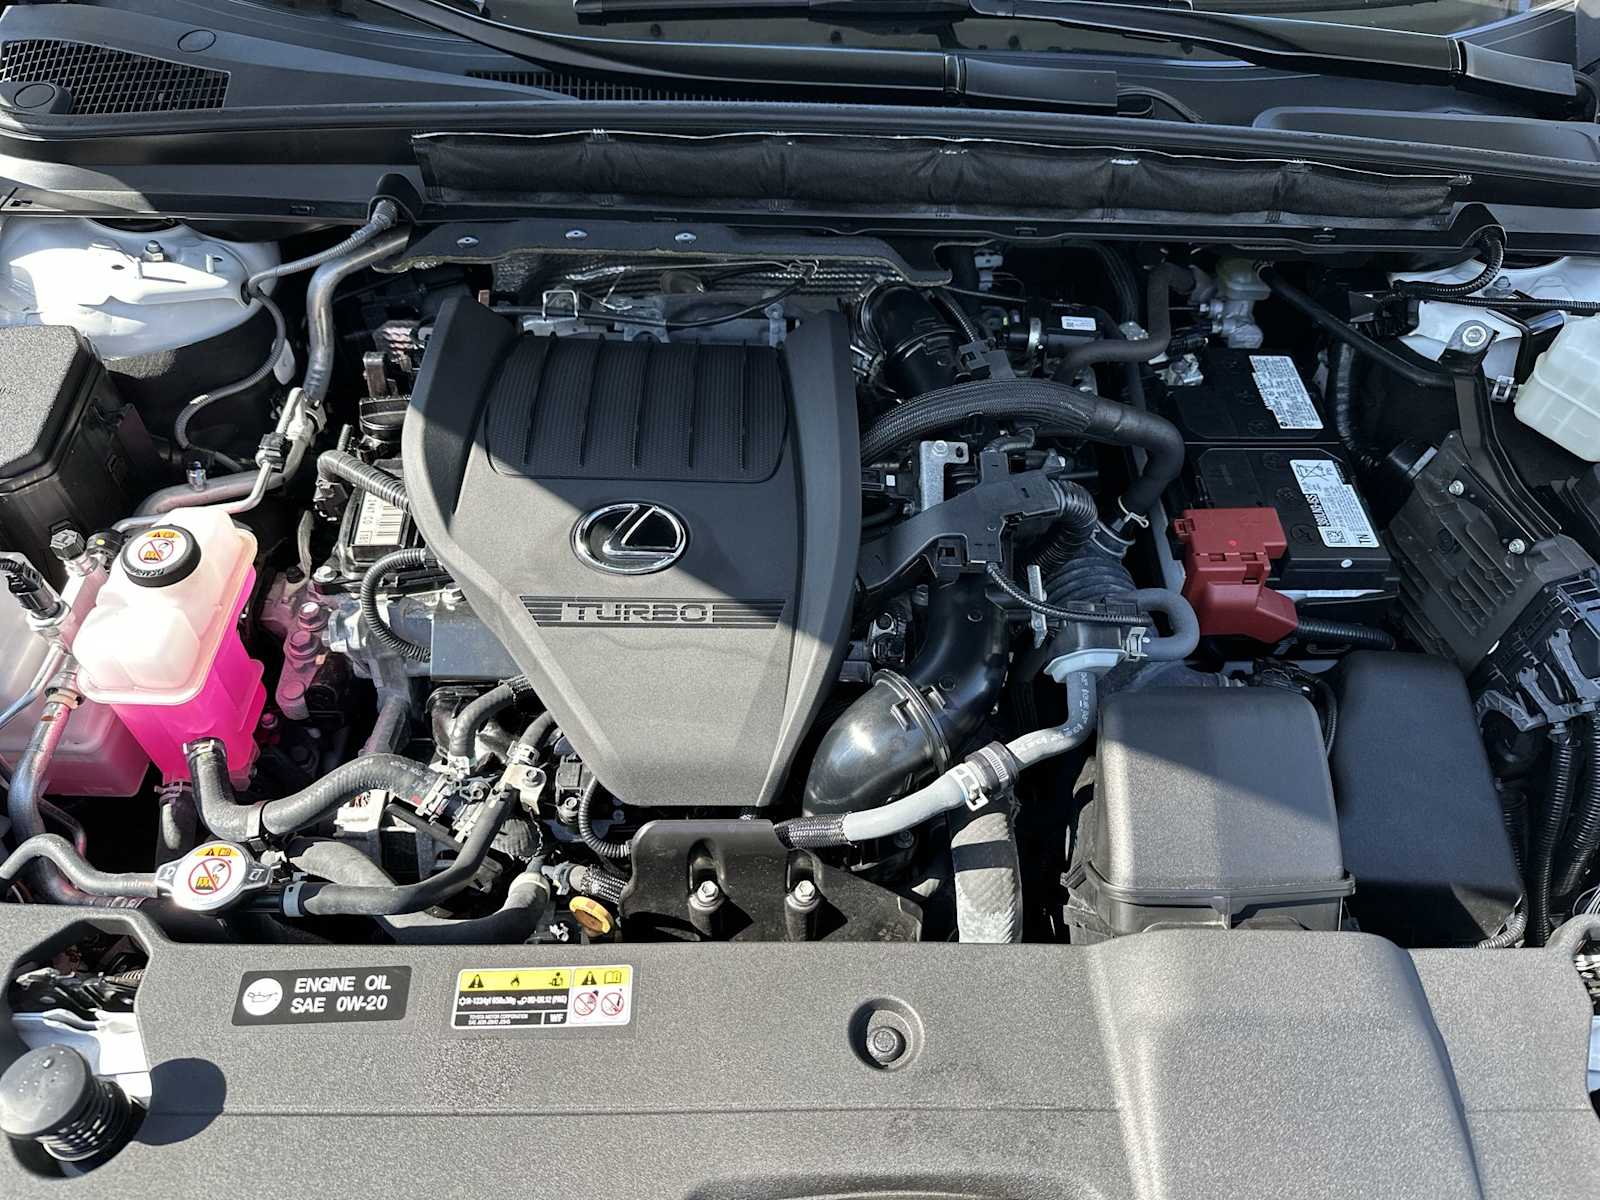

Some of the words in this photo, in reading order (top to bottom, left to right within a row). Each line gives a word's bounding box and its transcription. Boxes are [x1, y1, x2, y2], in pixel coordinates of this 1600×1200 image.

[567, 603, 708, 622] TURBO
[294, 976, 356, 993] ENGINE
[364, 975, 392, 990] OIL
[290, 996, 326, 1013] SAE
[336, 995, 388, 1012] 0W-20
